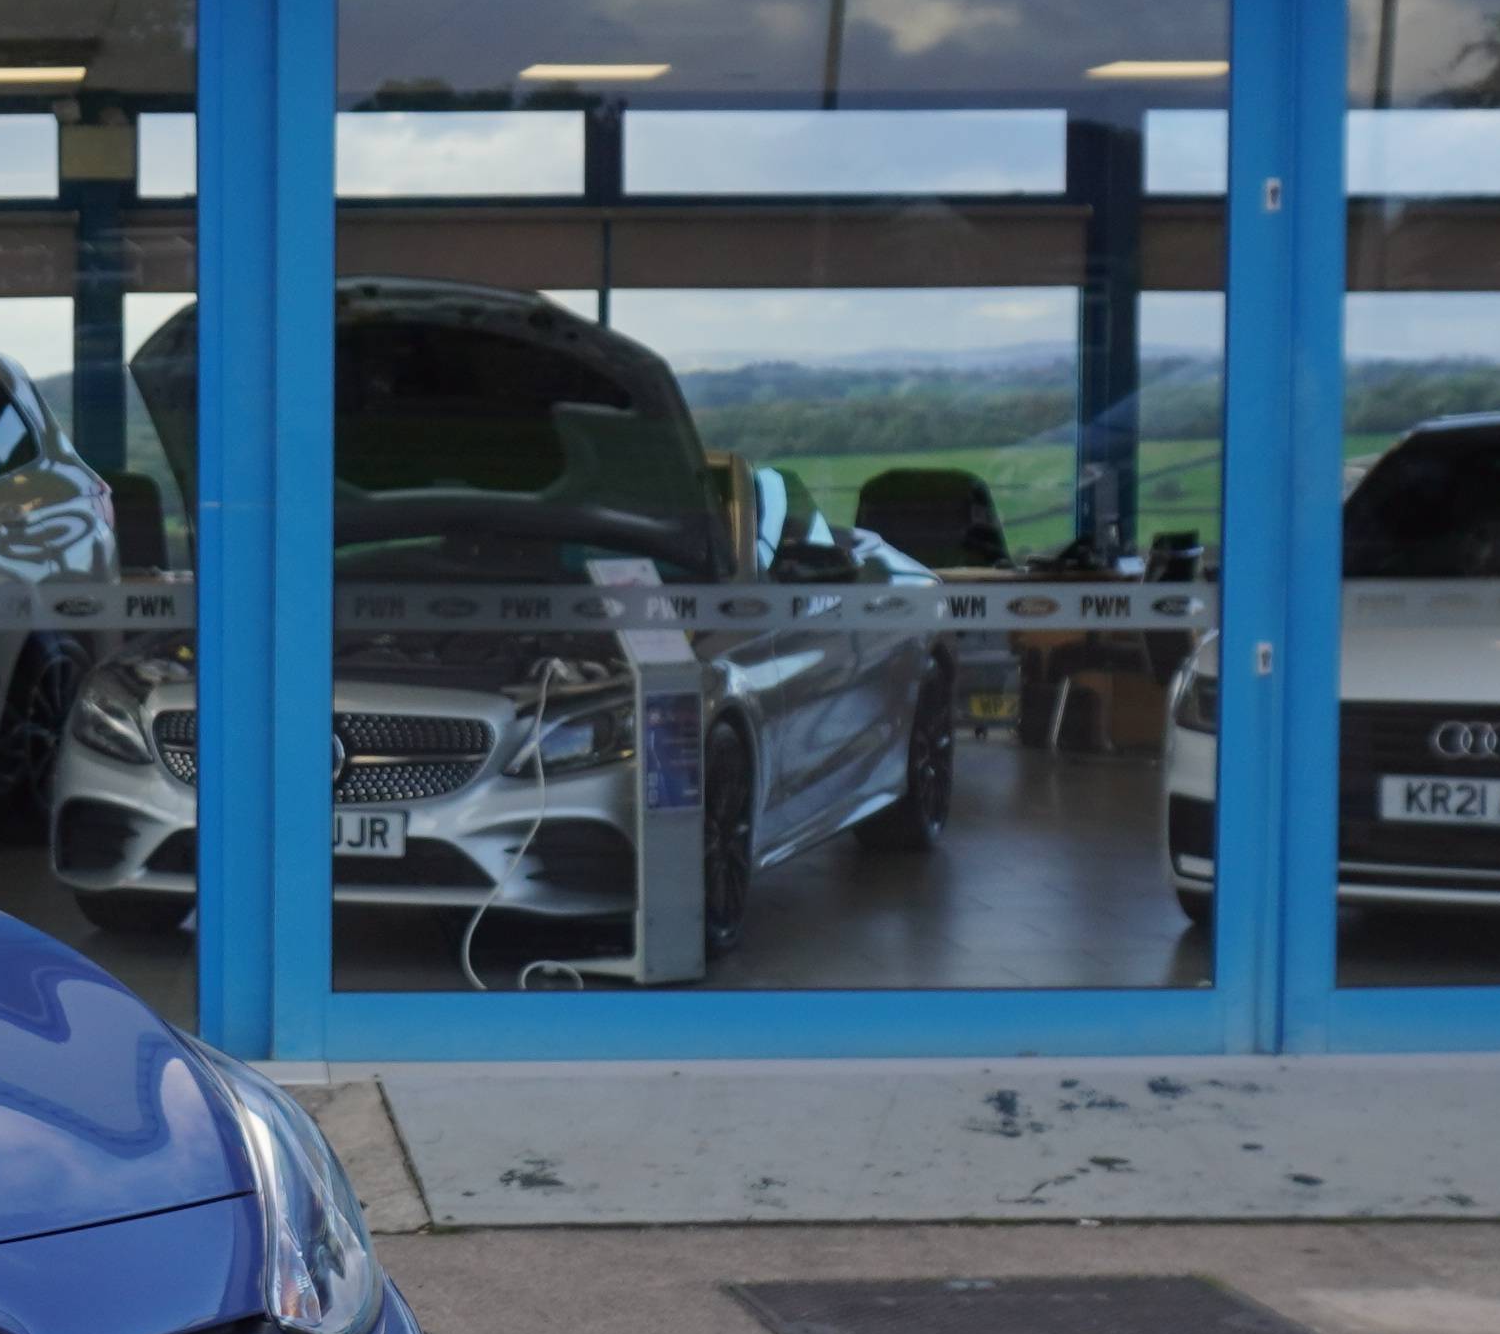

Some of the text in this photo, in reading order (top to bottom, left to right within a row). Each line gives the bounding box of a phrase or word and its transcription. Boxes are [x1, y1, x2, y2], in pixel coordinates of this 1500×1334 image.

[126, 595, 176, 617] PWM
[1081, 595, 1131, 618] PWM
[1406, 782, 1487, 817] KR21
